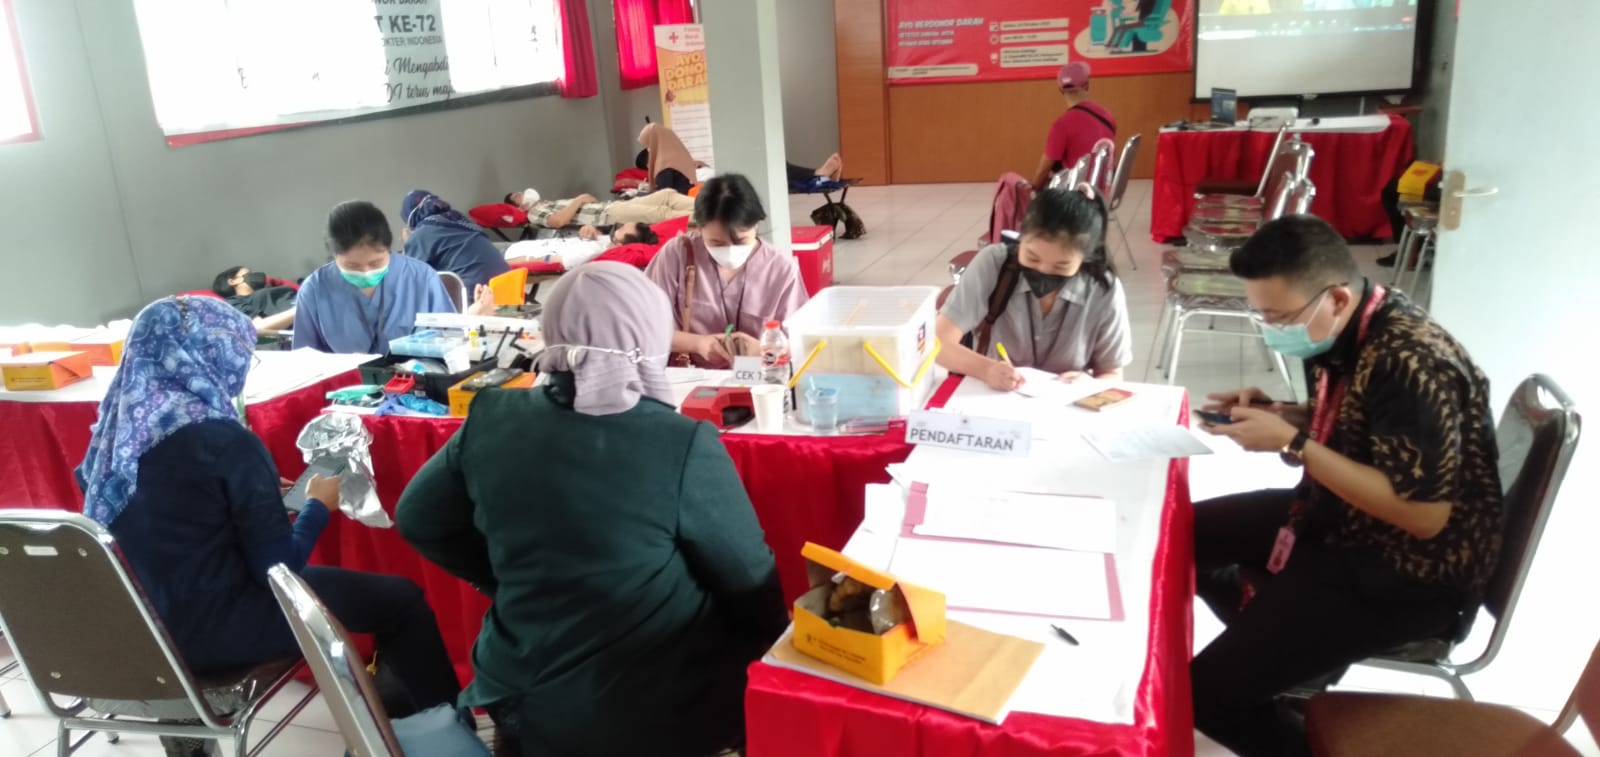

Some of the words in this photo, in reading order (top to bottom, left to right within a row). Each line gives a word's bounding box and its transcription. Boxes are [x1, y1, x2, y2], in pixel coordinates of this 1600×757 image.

[389, 15, 436, 33] KE-72
[735, 370, 754, 381] CEK
[910, 427, 1014, 452] PENDAFTARAN
